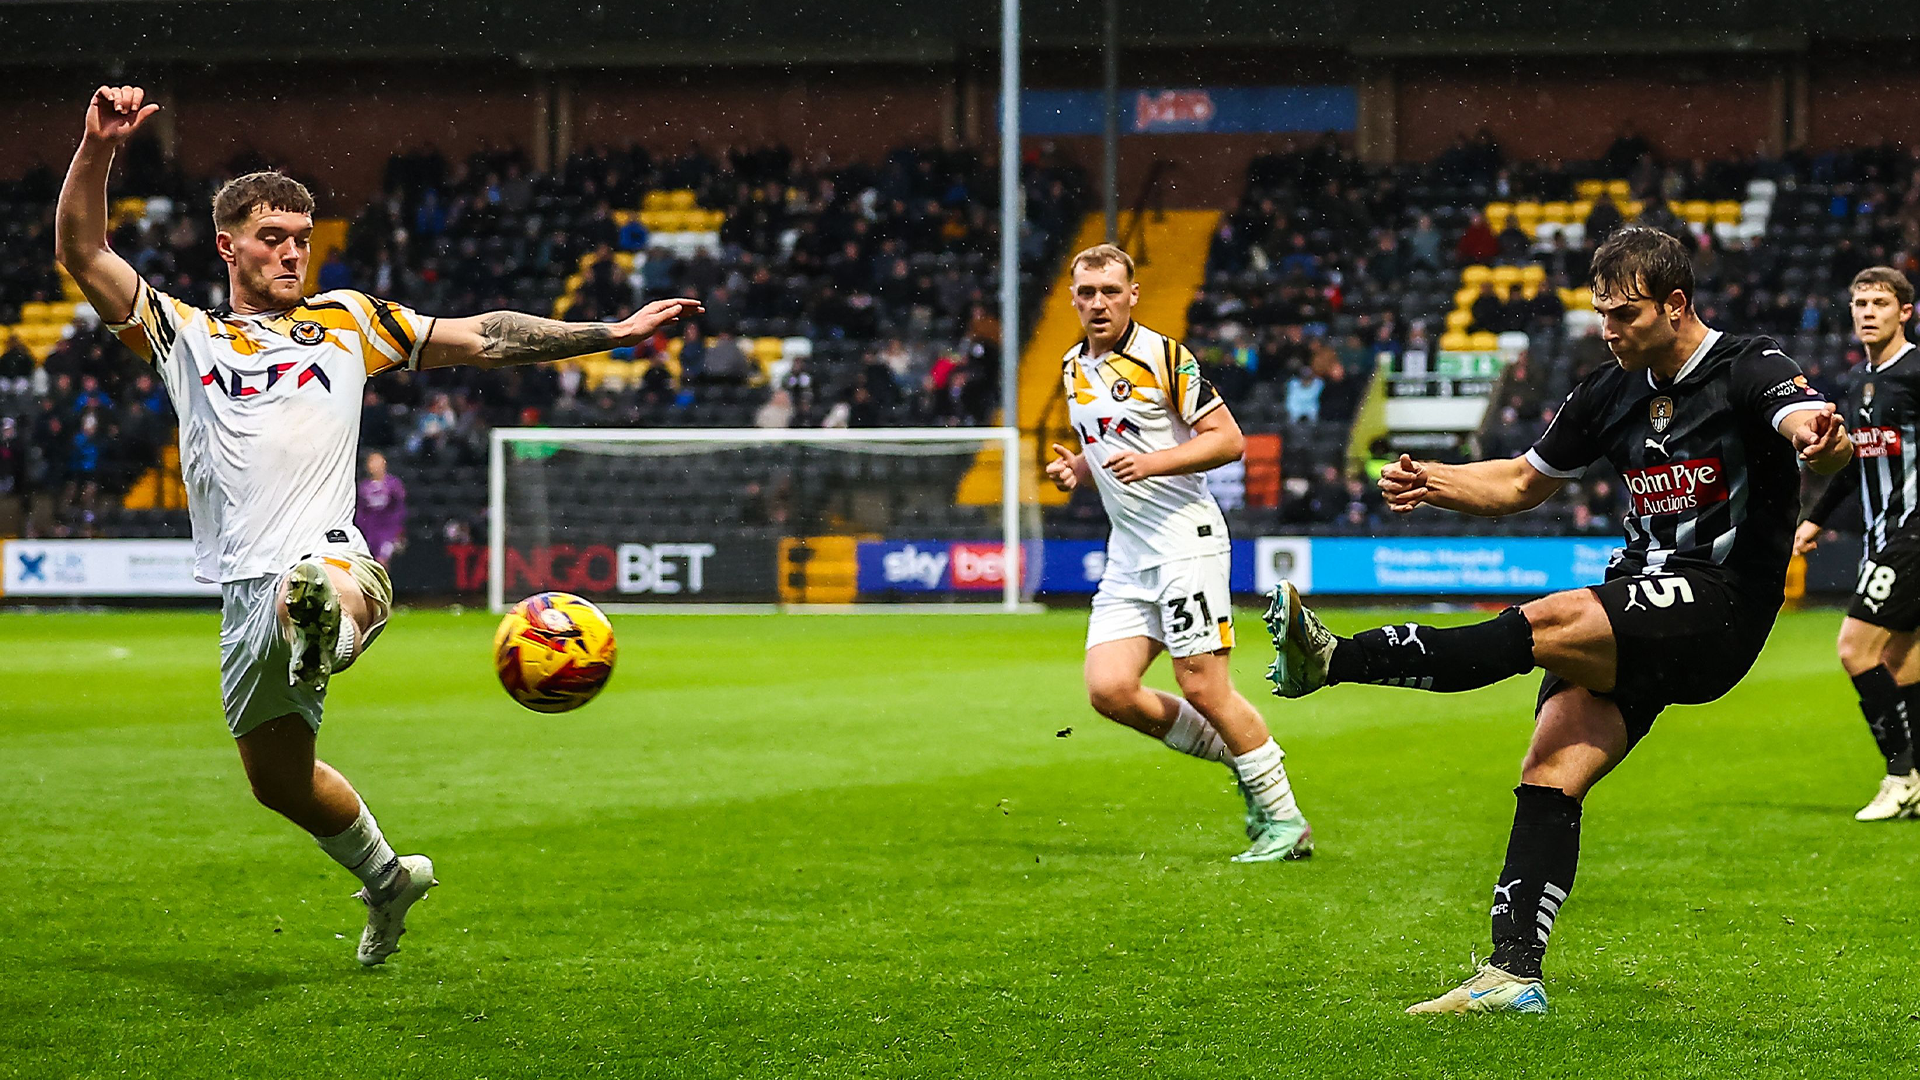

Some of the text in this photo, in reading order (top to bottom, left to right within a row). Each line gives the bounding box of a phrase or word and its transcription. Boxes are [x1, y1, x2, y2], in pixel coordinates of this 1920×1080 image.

[200, 362, 331, 396] ALFA
[1079, 416, 1141, 445] LFA
[1623, 464, 1717, 495] John Pye
[1644, 494, 1697, 515] Auctions
[883, 545, 1021, 590] sky be
[1856, 560, 1896, 600] 18
[1168, 592, 1213, 633] 31
